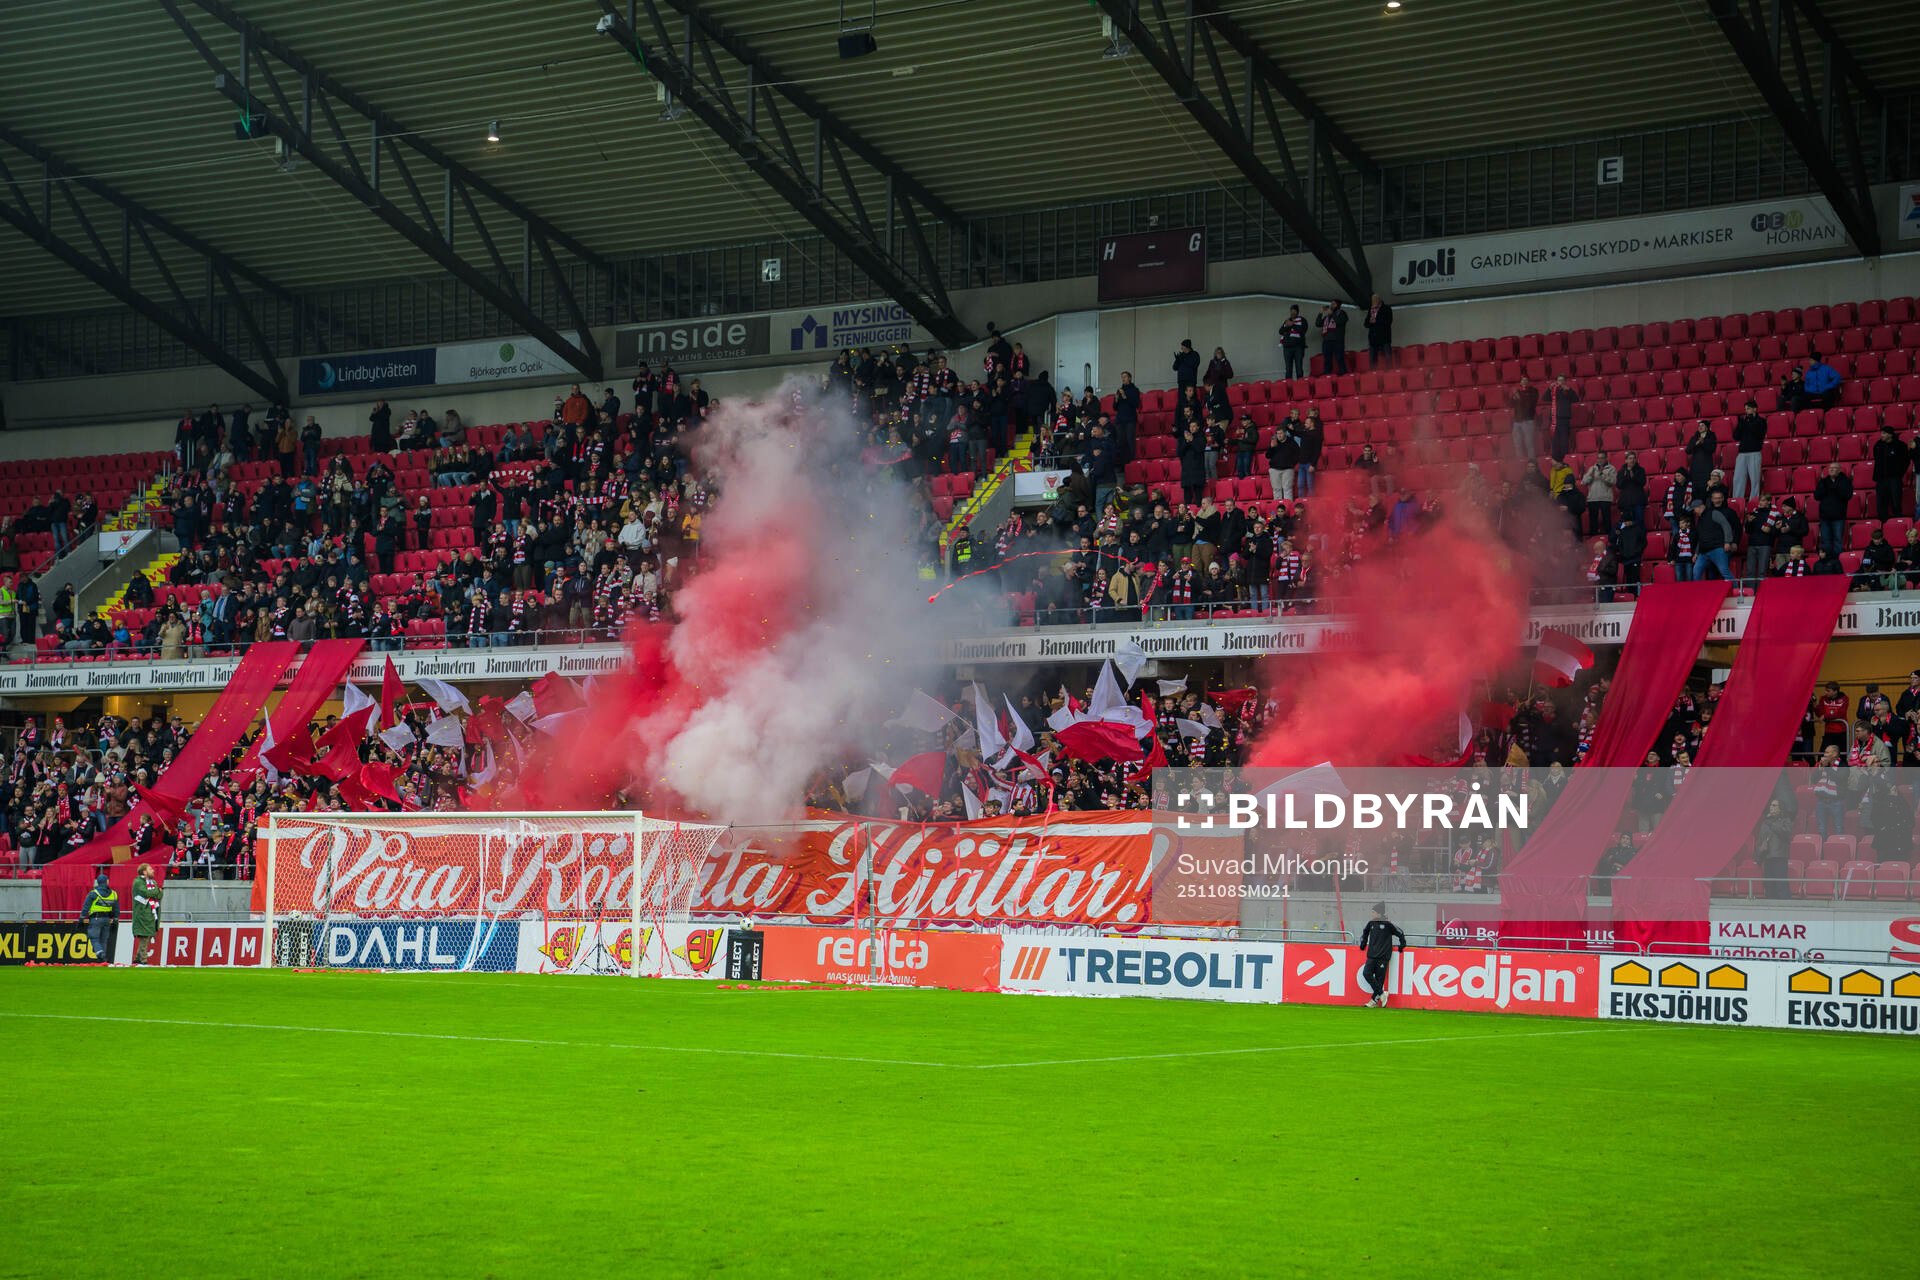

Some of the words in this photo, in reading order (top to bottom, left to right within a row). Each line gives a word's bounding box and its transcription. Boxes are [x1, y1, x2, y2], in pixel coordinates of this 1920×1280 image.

[1603, 159, 1618, 182] E
[1103, 241, 1116, 261] H
[1189, 232, 1201, 252] G
[1471, 249, 1547, 270] GARDINER
[1559, 239, 1640, 260] SOLSKYDD
[1653, 228, 1734, 249] MARKISER
[1767, 225, 1836, 245] HÖRNAN
[638, 323, 747, 353] inside
[833, 332, 912, 352] STENHUGGERI
[338, 363, 417, 383] Lindbytvätten
[470, 363, 517, 378] Björkegrens
[519, 361, 543, 374] Optik
[1038, 638, 1115, 655] Barometern
[1222, 631, 1304, 650] Barometern
[25, 673, 78, 688] Barometern
[87, 671, 141, 687] Barometern
[150, 669, 205, 685] Barometern
[415, 660, 475, 675] Barometern
[485, 658, 547, 673] Barometern
[558, 655, 622, 671] Barometern
[300, 825, 472, 911] Våra
[329, 926, 456, 965] DAHL
[1583, 930, 1614, 944] LUS
[1719, 923, 1807, 939] KALMAR
[732, 941, 743, 979] SELECT
[752, 942, 760, 980] SELECT
[817, 932, 929, 970] renta
[1059, 948, 1273, 990] TREBOLIT
[1610, 990, 1748, 1023] EKSJÖHUS
[1788, 998, 1920, 1033] EKSJÖHU
